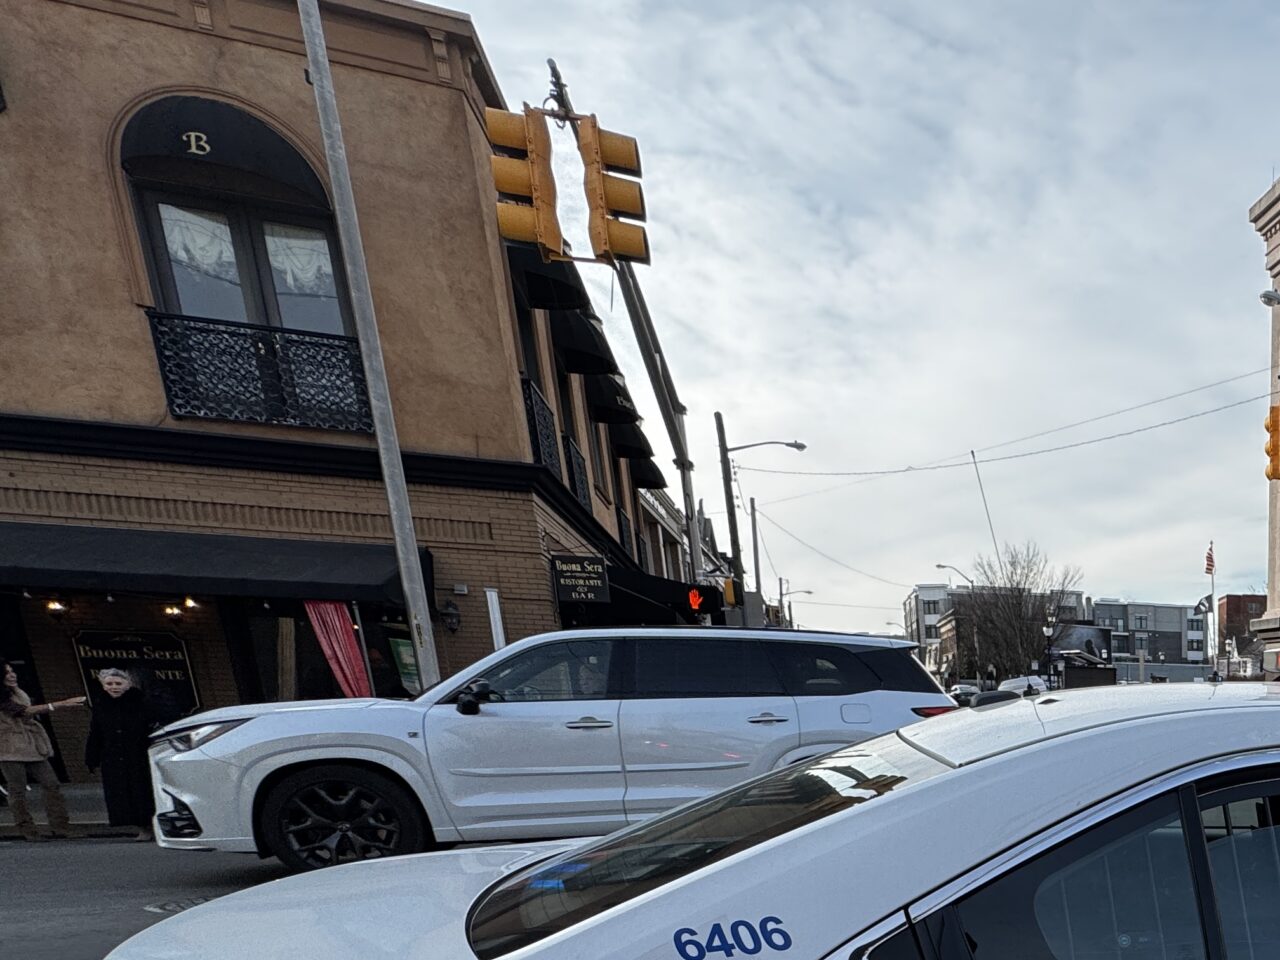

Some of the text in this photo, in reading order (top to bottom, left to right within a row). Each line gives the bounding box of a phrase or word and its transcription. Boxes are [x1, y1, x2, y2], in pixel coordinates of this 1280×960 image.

[182, 131, 211, 155] B
[555, 560, 603, 573] Buona Sera
[571, 592, 595, 600] BAR
[79, 644, 184, 660] Buona Sera
